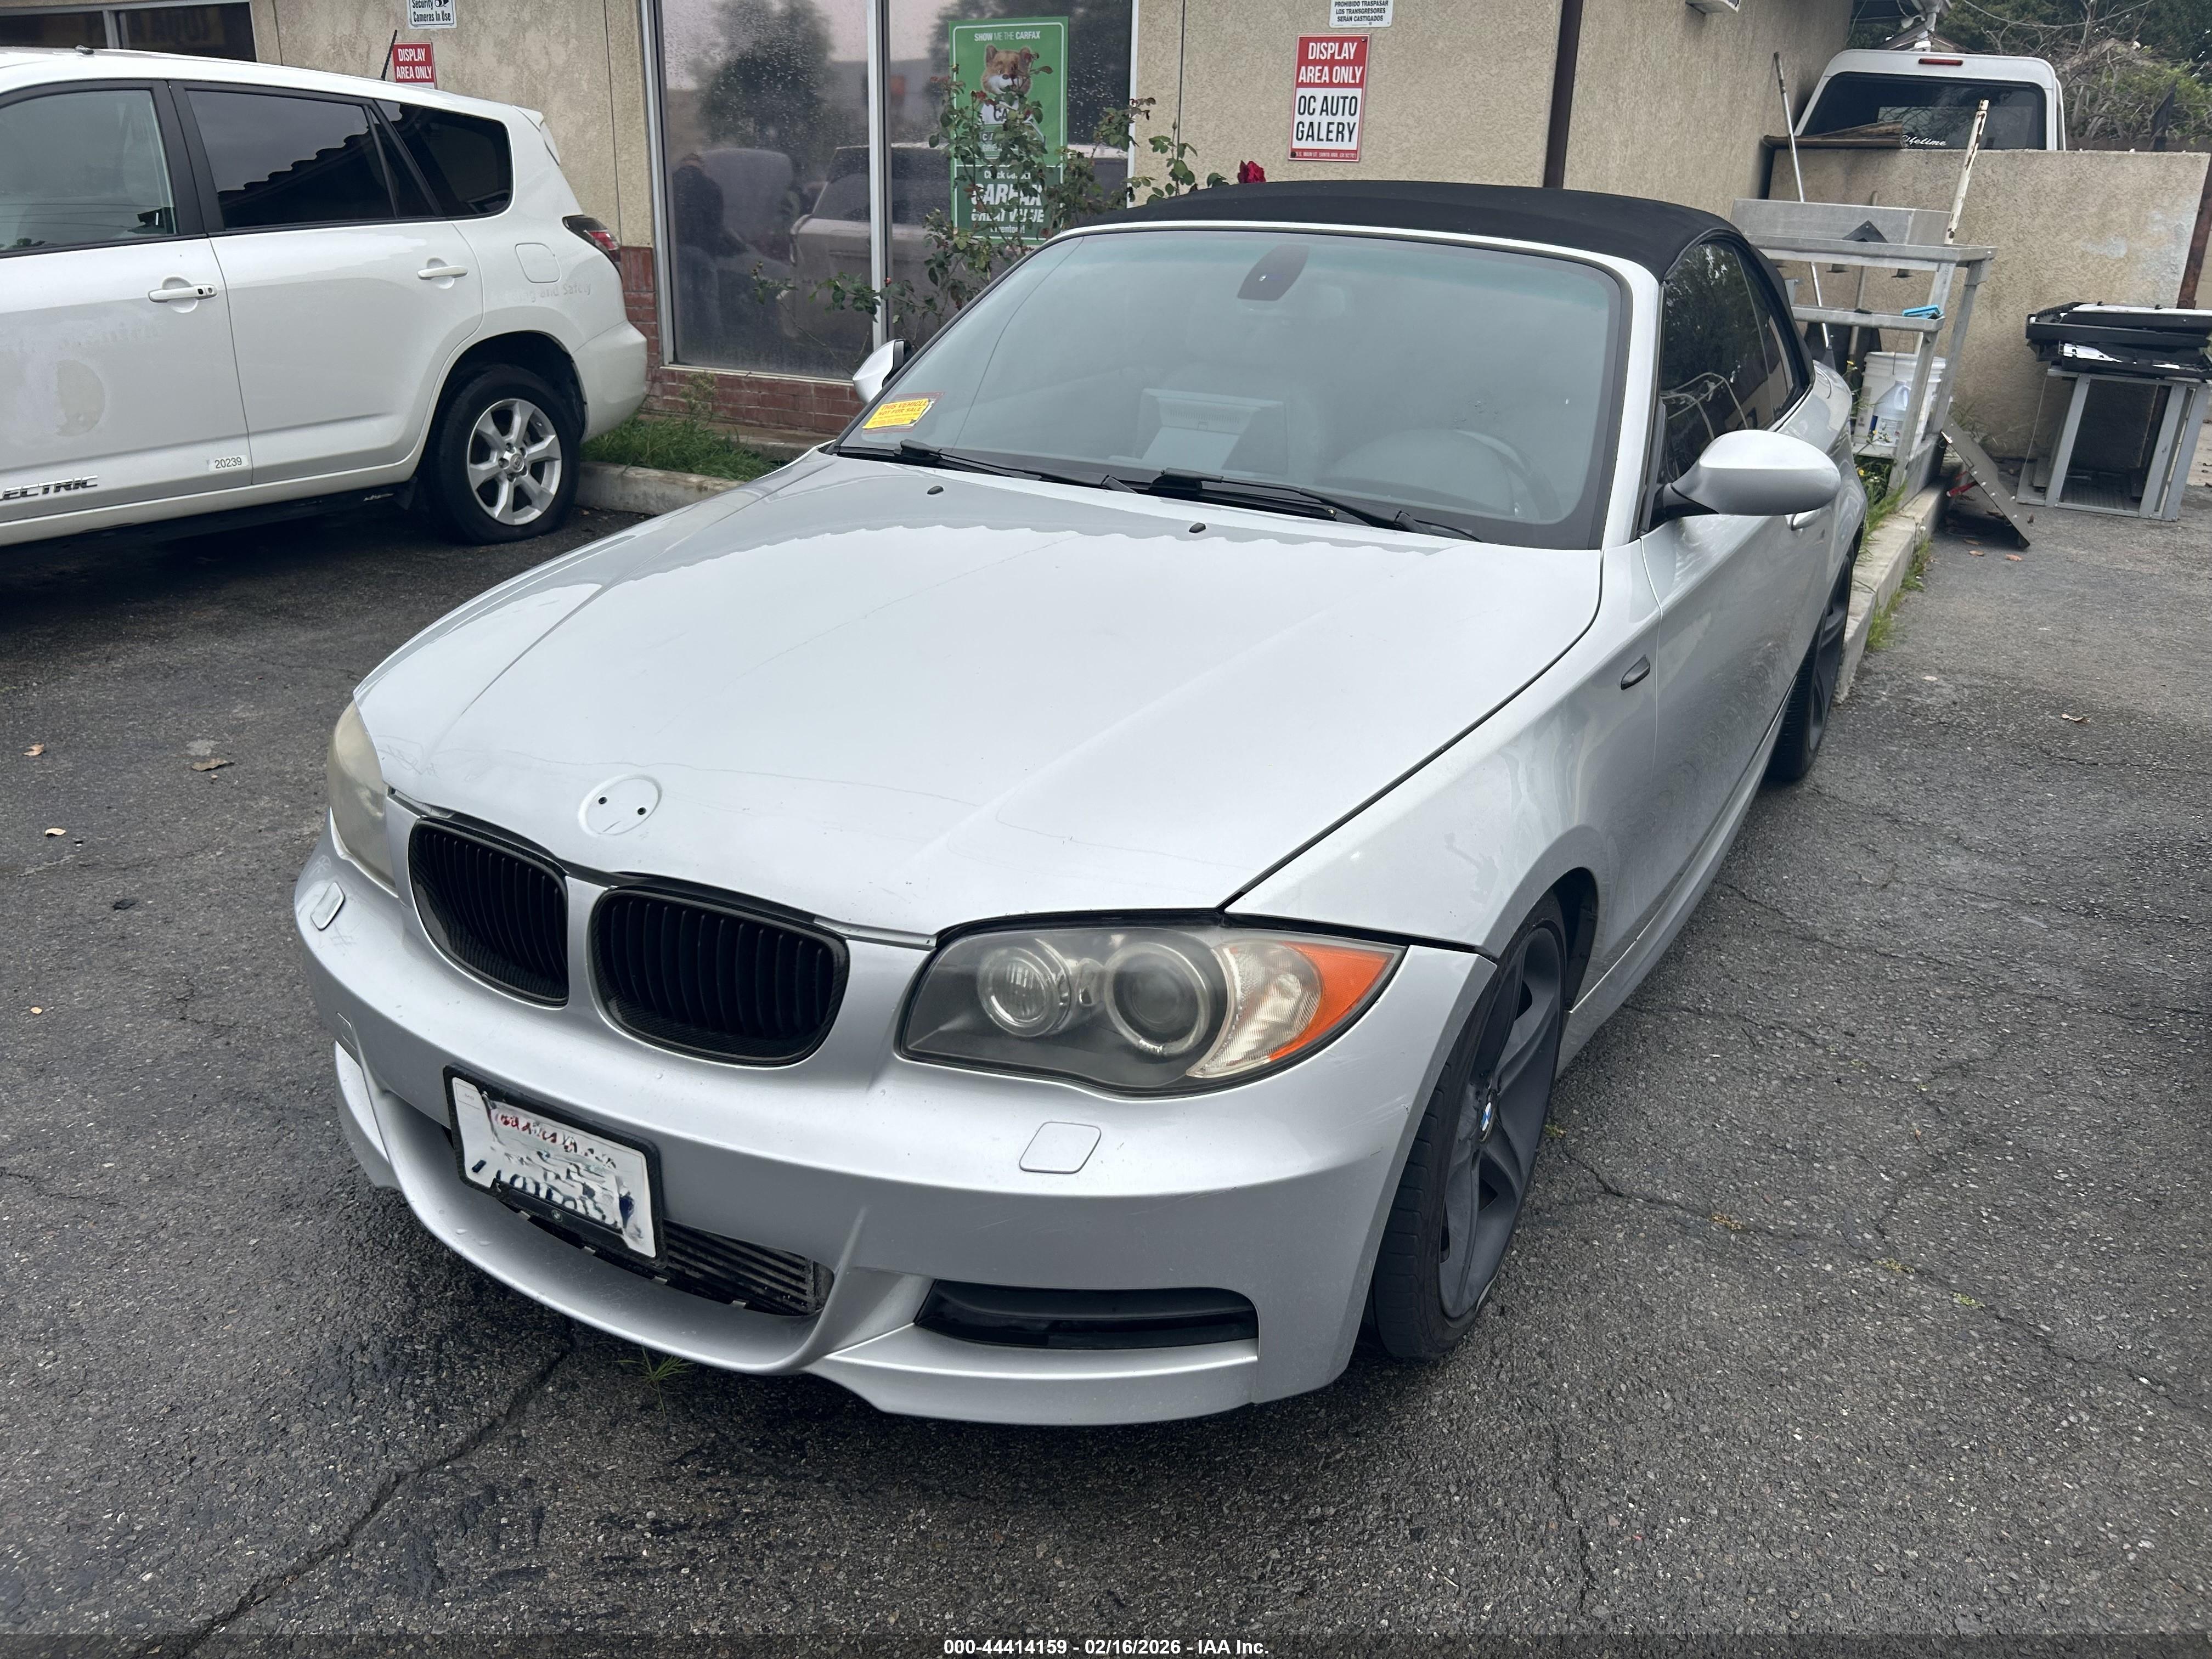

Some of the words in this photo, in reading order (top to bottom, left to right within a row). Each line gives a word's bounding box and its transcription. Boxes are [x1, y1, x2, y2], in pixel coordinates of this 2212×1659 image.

[412, 0, 433, 10] Security
[413, 12, 435, 22] Cameras
[436, 10, 441, 21] In
[441, 10, 451, 21] Use
[974, 32, 992, 42] SHOW
[994, 32, 1003, 41] ME
[1004, 31, 1014, 40] THE
[1015, 31, 1041, 40] CARFAX
[398, 48, 426, 61] DISPLAY
[1308, 42, 1357, 60] DISPLAY
[396, 66, 415, 79] AREA
[415, 66, 432, 79] ONLY
[1298, 66, 1329, 83] AREA
[1331, 66, 1363, 83] ONLY
[1297, 95, 1316, 116] OC
[1319, 95, 1358, 116] AUTO
[1296, 121, 1356, 142] GALERY
[215, 456, 242, 469] 20239
[0, 475, 98, 501] ECTRIC
